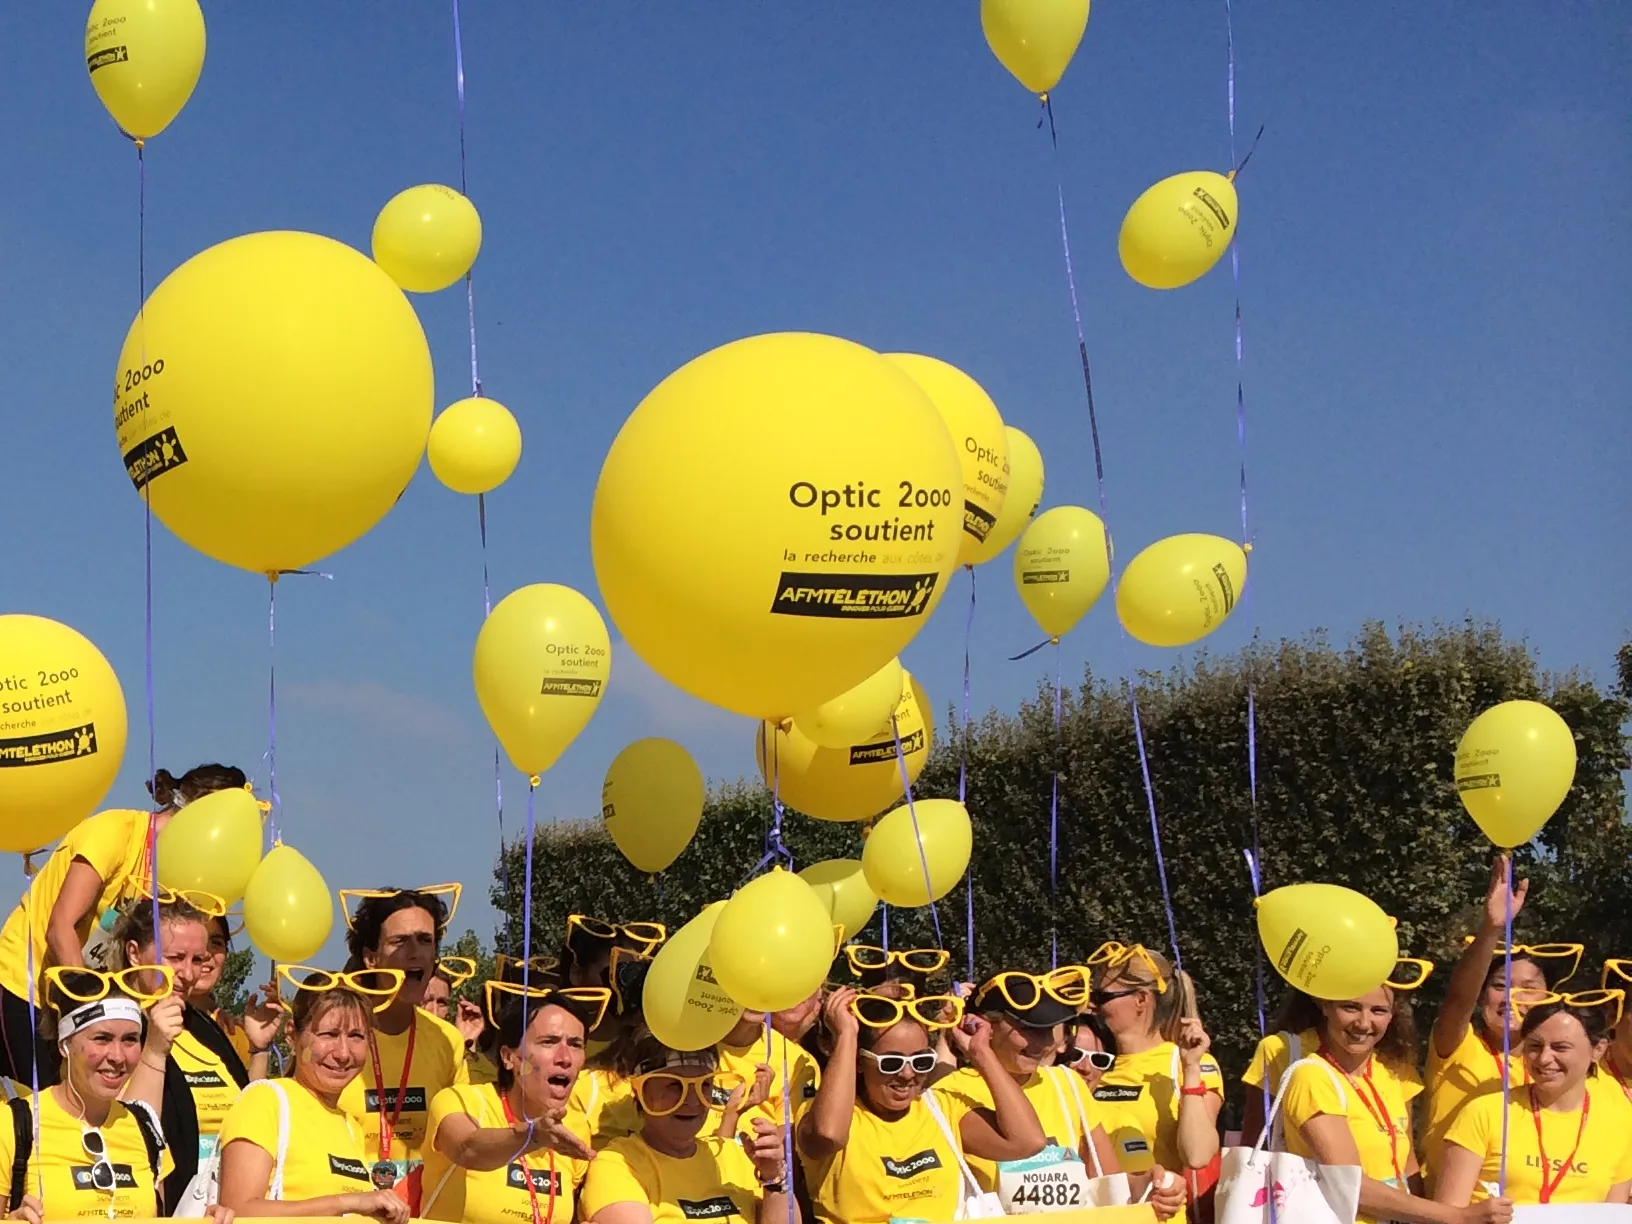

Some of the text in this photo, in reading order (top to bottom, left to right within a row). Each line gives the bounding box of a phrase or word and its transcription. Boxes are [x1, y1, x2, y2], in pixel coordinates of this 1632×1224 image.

[125, 359, 165, 392] 2000
[965, 437, 999, 468] Optic
[789, 481, 951, 516] Optic 2000
[830, 517, 935, 541] soutient
[783, 548, 797, 562] la
[804, 550, 877, 564] recherche
[546, 644, 605, 657] Optic 2000
[561, 657, 599, 668] soutient
[37, 667, 79, 688] 2000
[2, 689, 73, 714] soutient
[688, 998, 714, 1013] 2000
[910, 1156, 936, 1170] 2000
[538, 1177, 560, 1188] 200
[1023, 1173, 1069, 1183] NOUARA
[1011, 1183, 1081, 1206] 44882
